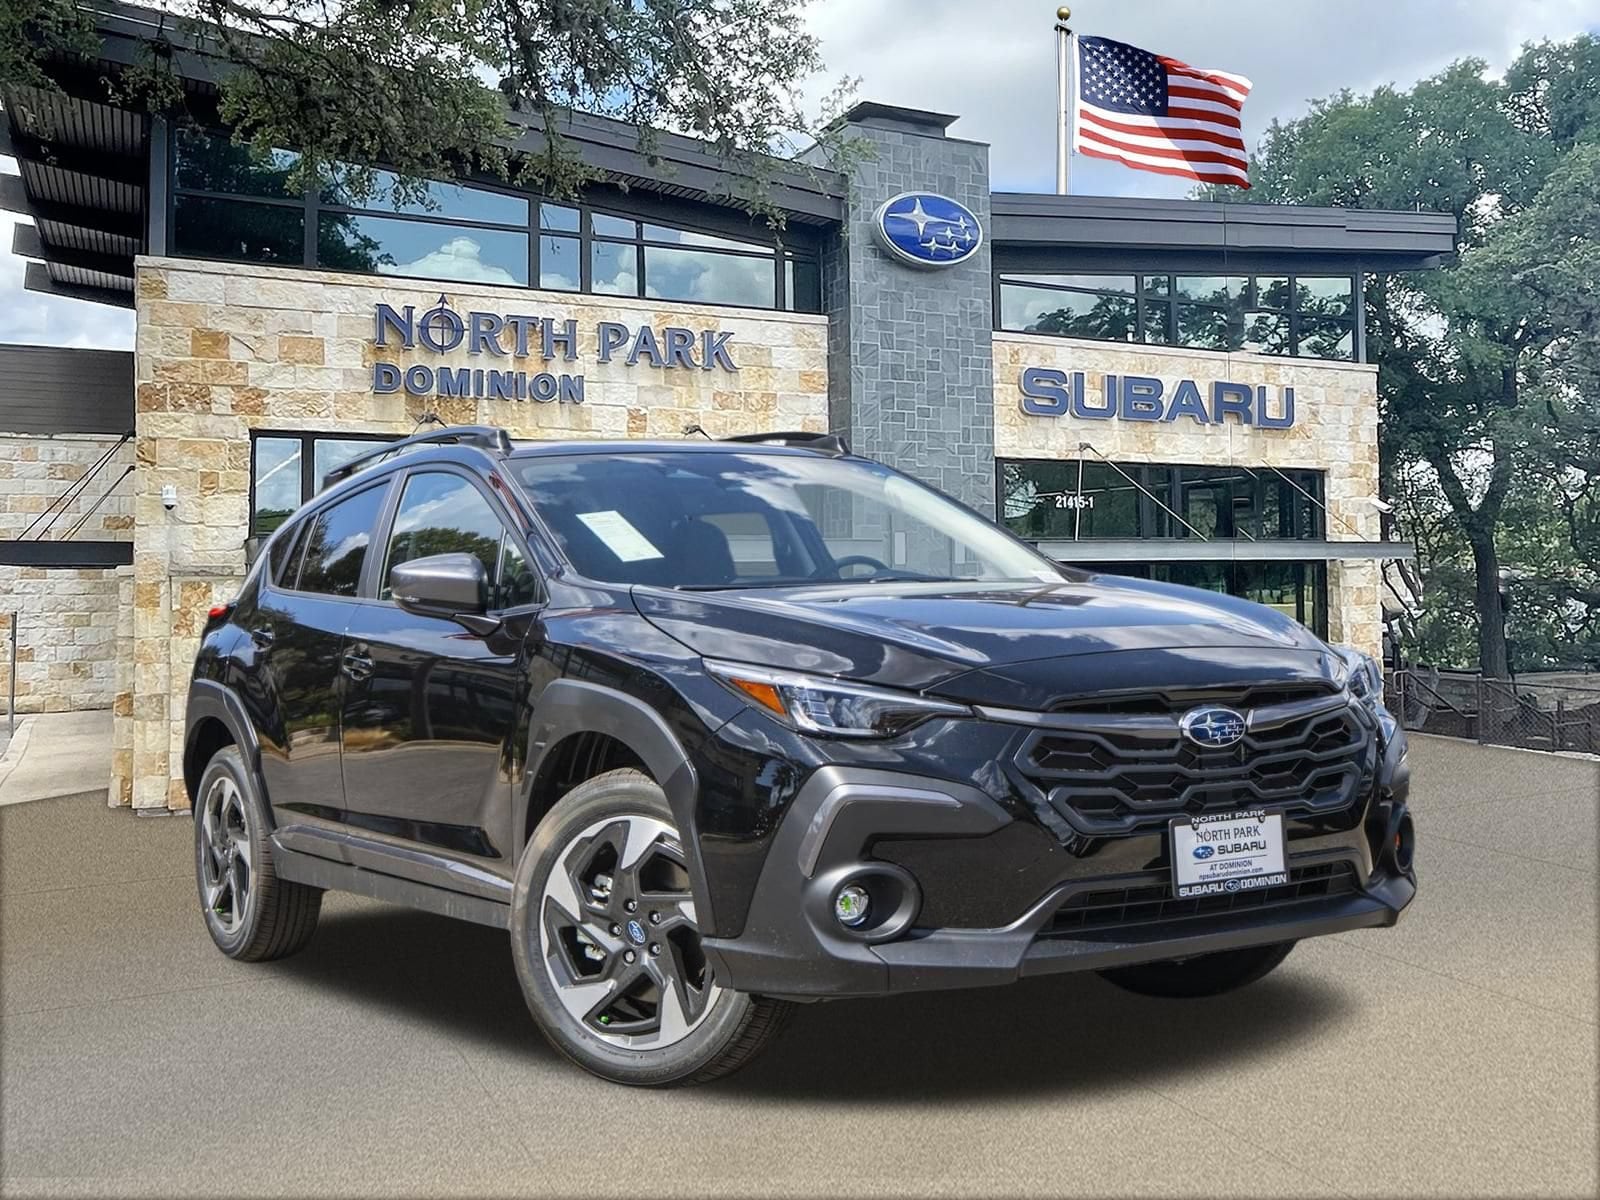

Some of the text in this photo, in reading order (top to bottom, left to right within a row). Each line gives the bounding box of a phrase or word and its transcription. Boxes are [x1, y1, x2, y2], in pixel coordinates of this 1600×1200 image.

[374, 293, 741, 373] NORTH PARK
[373, 362, 585, 403] DOMINION
[1019, 367, 1295, 429] SUBARU
[1191, 809, 1266, 824] NORTH PARK
[1196, 825, 1261, 843] NORTH PARK
[1217, 840, 1266, 855] SUBARU
[1209, 860, 1253, 872] AT DOMINION
[1179, 873, 1288, 897] SUBARU DOMINION
